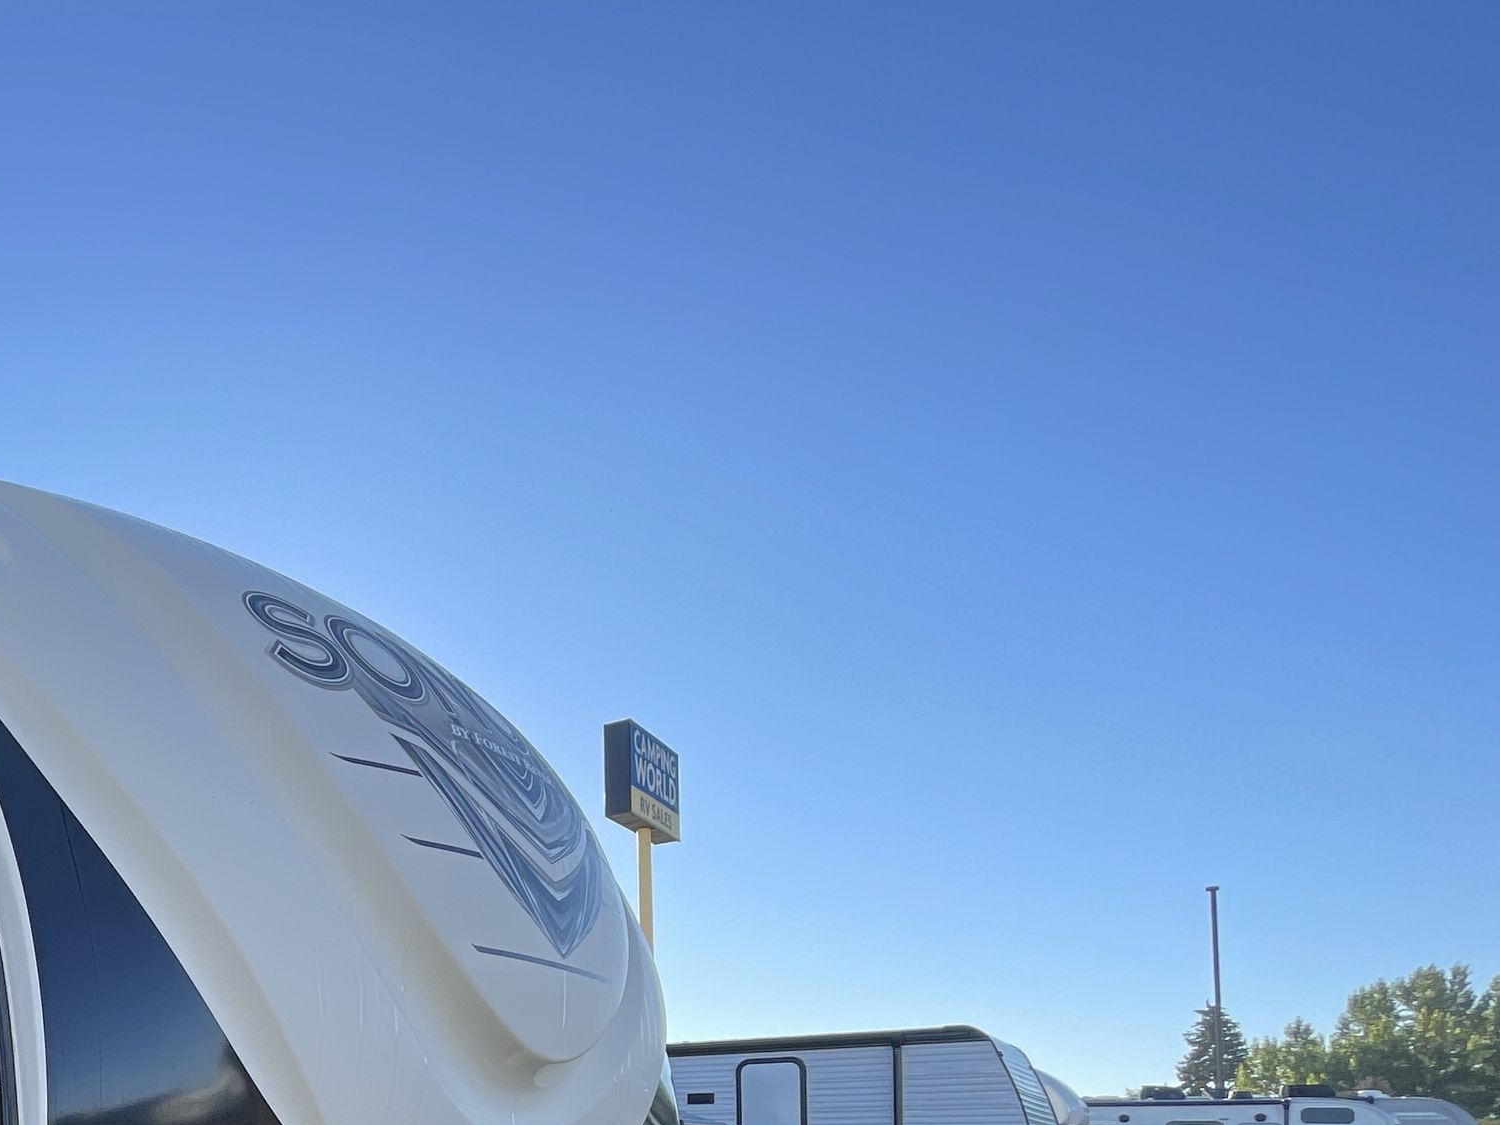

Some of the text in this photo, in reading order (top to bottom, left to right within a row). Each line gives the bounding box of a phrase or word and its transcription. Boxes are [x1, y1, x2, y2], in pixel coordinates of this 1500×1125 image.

[449, 722, 471, 741] BY
[633, 729, 677, 779] CAMPING
[634, 756, 677, 806] WORLD
[639, 796, 673, 830] RV SALES
